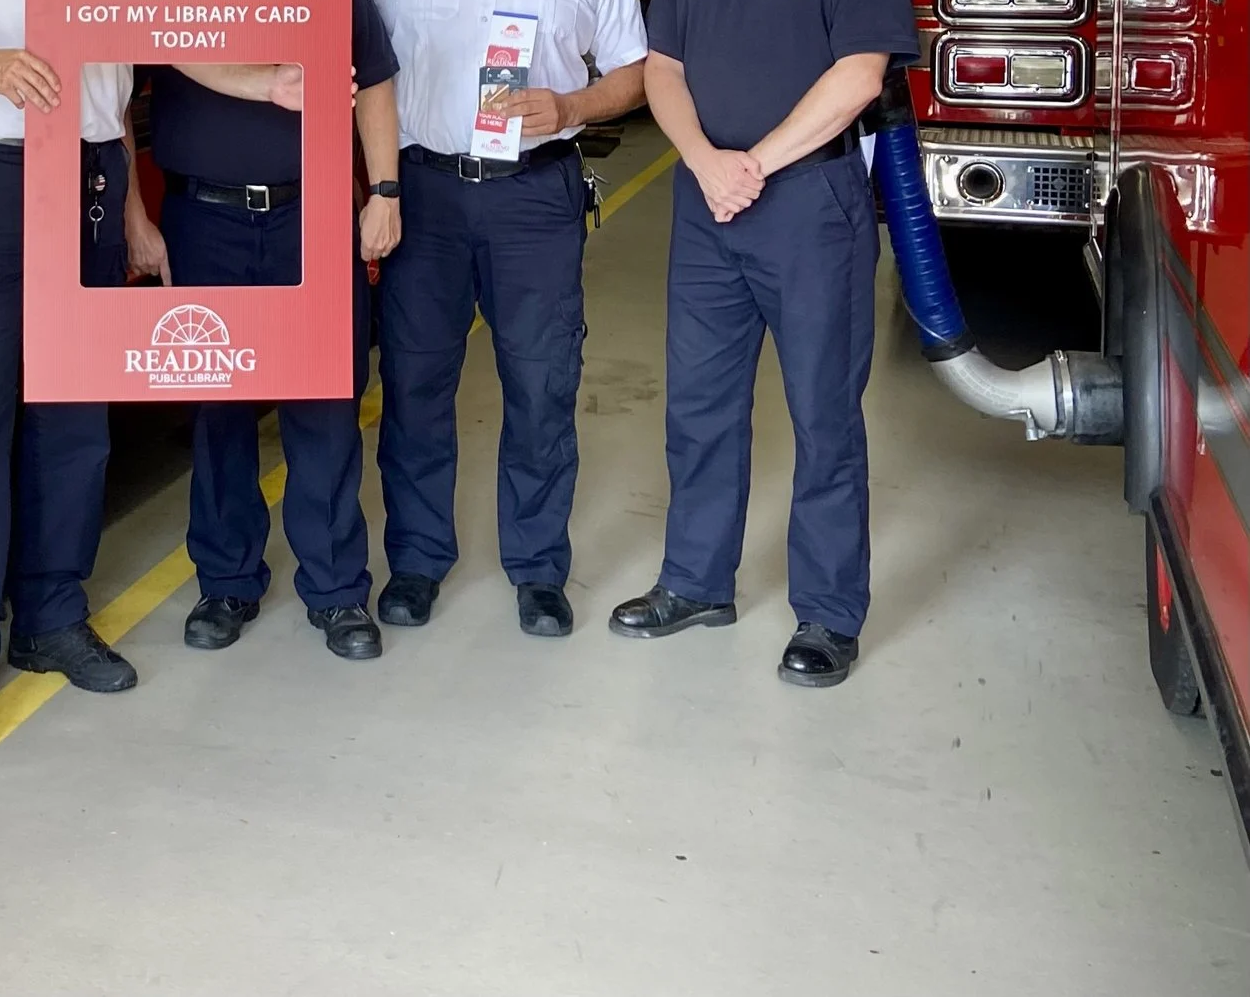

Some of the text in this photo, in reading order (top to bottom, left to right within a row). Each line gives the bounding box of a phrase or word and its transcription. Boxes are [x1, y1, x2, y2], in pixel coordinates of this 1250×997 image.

[65, 5, 311, 23] I GOT MY LIBRARY CARD
[151, 31, 227, 48] TODAY!
[125, 348, 256, 372] READING
[149, 373, 232, 383] PUBLIC LIBRARY
